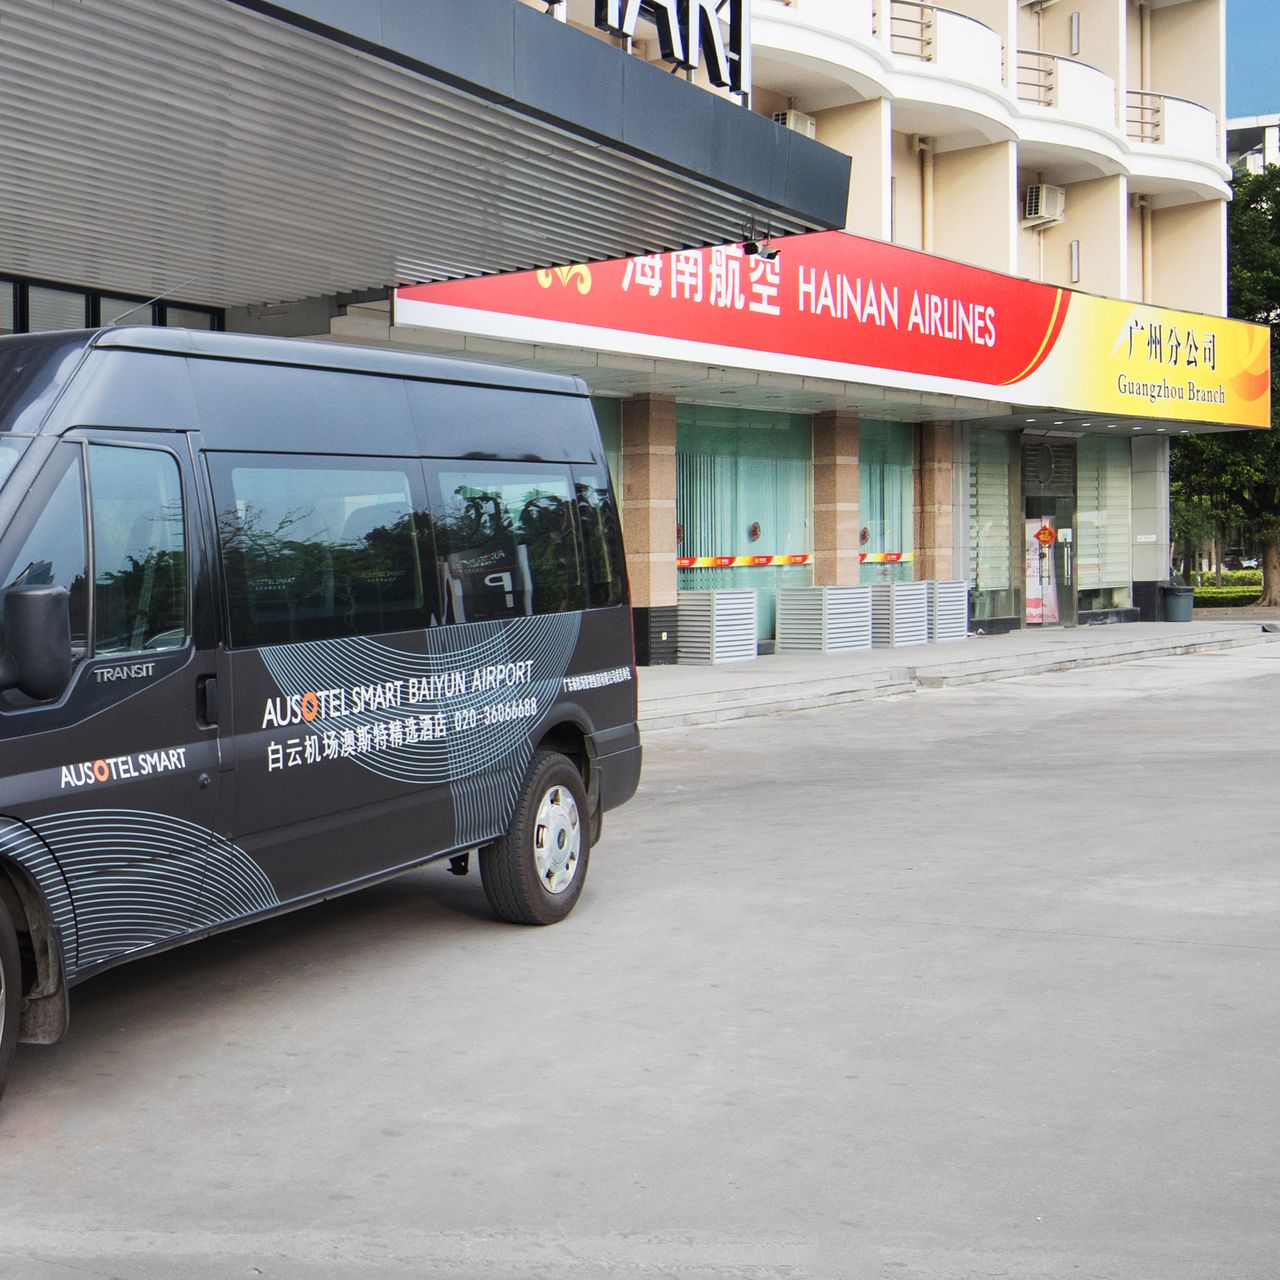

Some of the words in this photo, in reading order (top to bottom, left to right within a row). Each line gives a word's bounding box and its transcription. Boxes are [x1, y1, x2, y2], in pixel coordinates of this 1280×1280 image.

[798, 265, 900, 330] HAINAN
[907, 289, 996, 348] AIRLINES
[1128, 319, 1216, 371] 广州分公司
[1117, 373, 1184, 404] Guangzhou
[1188, 381, 1225, 404] Branch
[93, 662, 156, 683] TRANSIT
[261, 687, 351, 729] AUSOTEL
[352, 680, 404, 715] SMART
[409, 671, 466, 704] BAIYUN
[471, 660, 534, 692] AIRPORT
[267, 712, 447, 772] 白云机场澳斯特精选酒店
[60, 755, 139, 789] AUSOTEL
[139, 748, 186, 775] SMART
